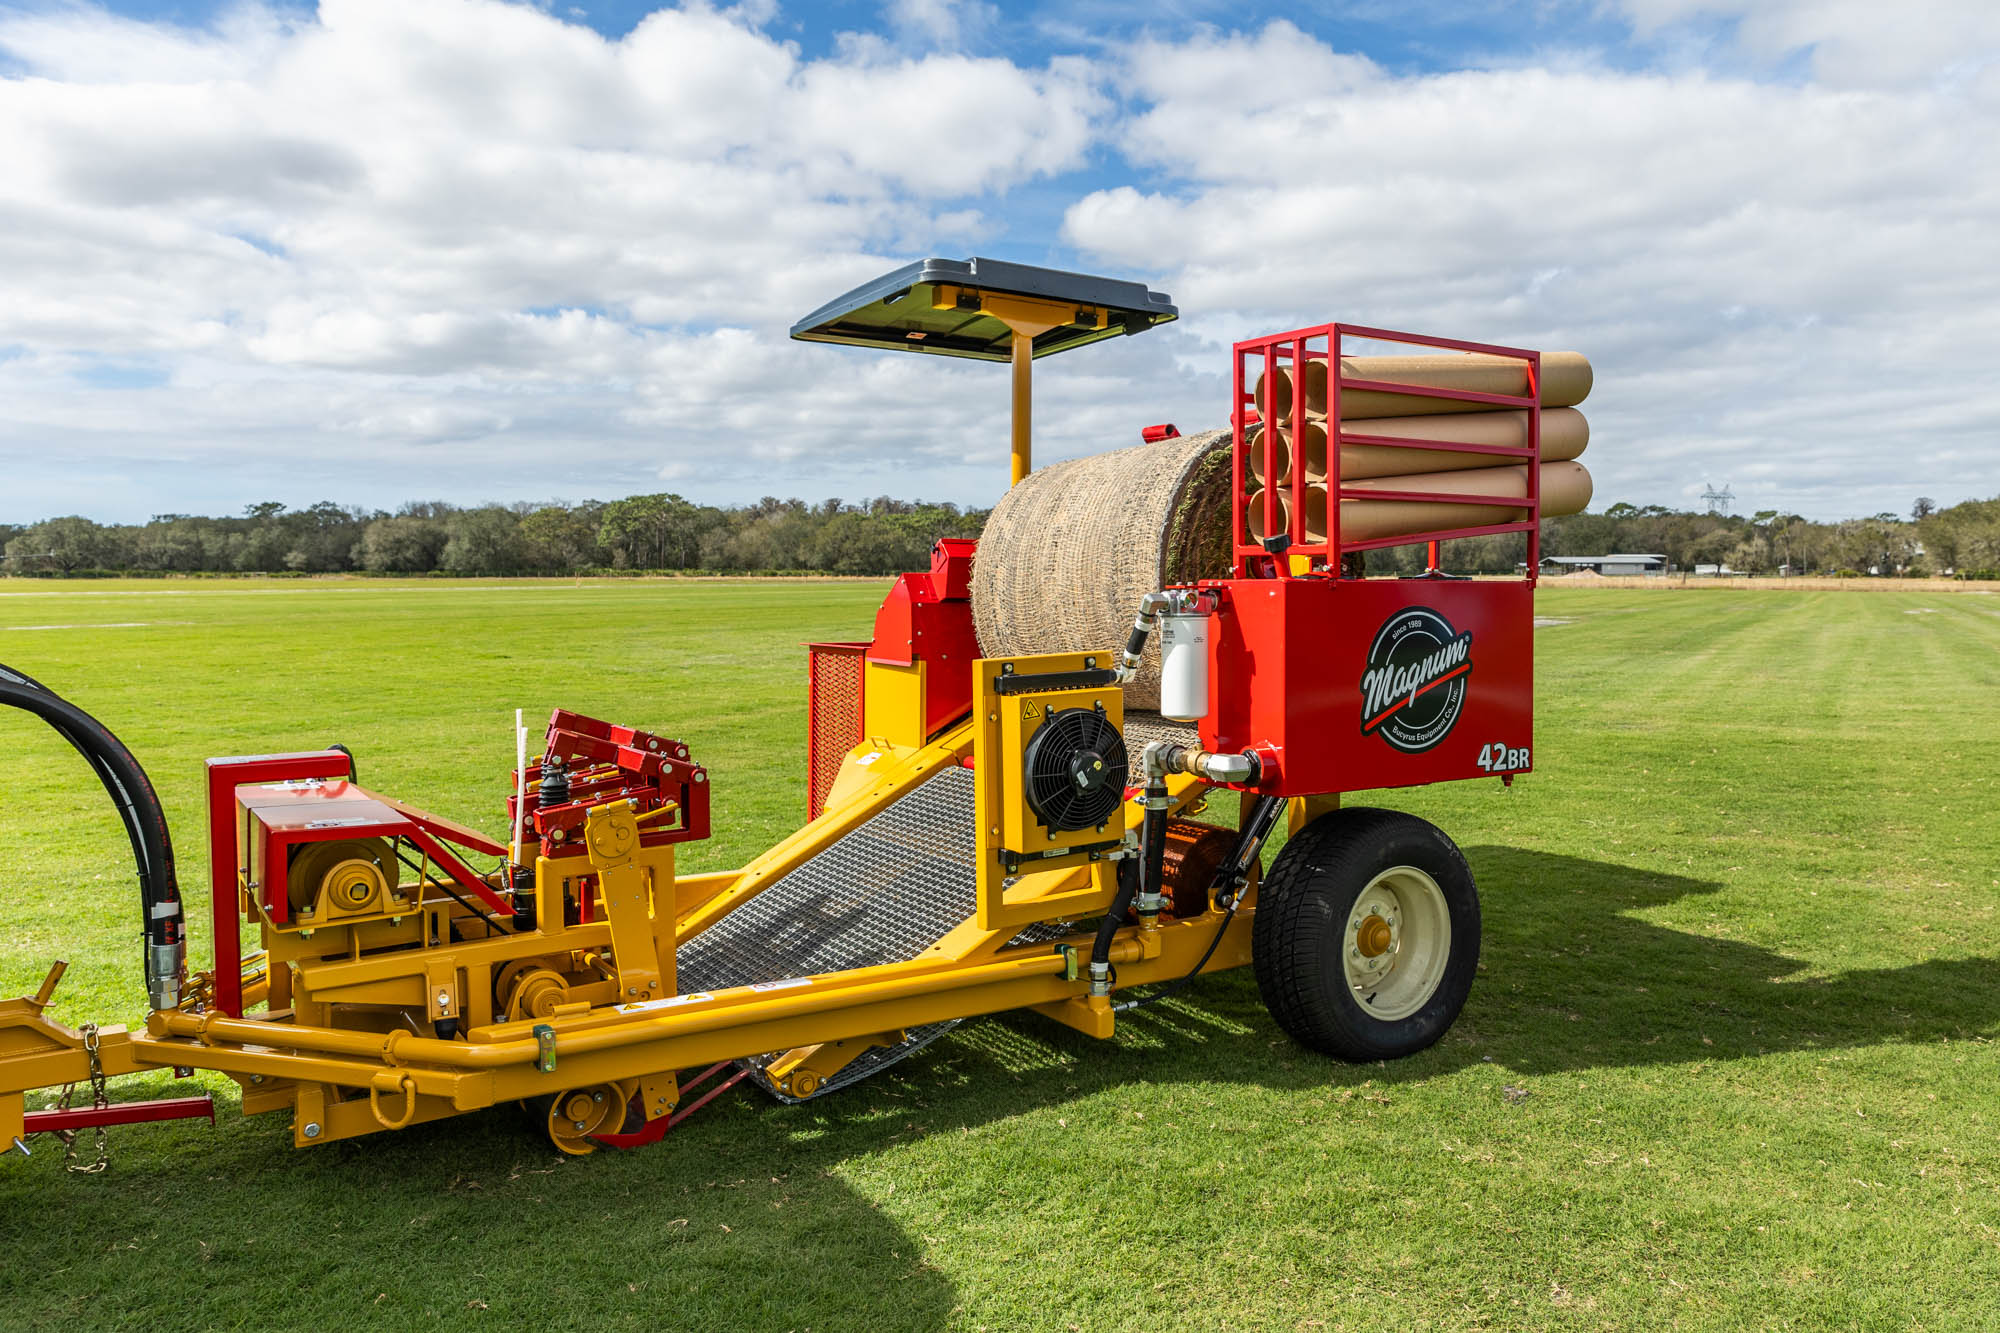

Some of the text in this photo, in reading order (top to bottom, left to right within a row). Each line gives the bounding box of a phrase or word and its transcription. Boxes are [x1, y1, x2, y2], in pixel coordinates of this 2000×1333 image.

[1392, 625, 1407, 640] since
[1363, 638, 1468, 720] Magnum
[1392, 725, 1416, 741] Bucyrus
[1416, 718, 1447, 741] Equipment
[1477, 742, 1530, 772] 42BR
